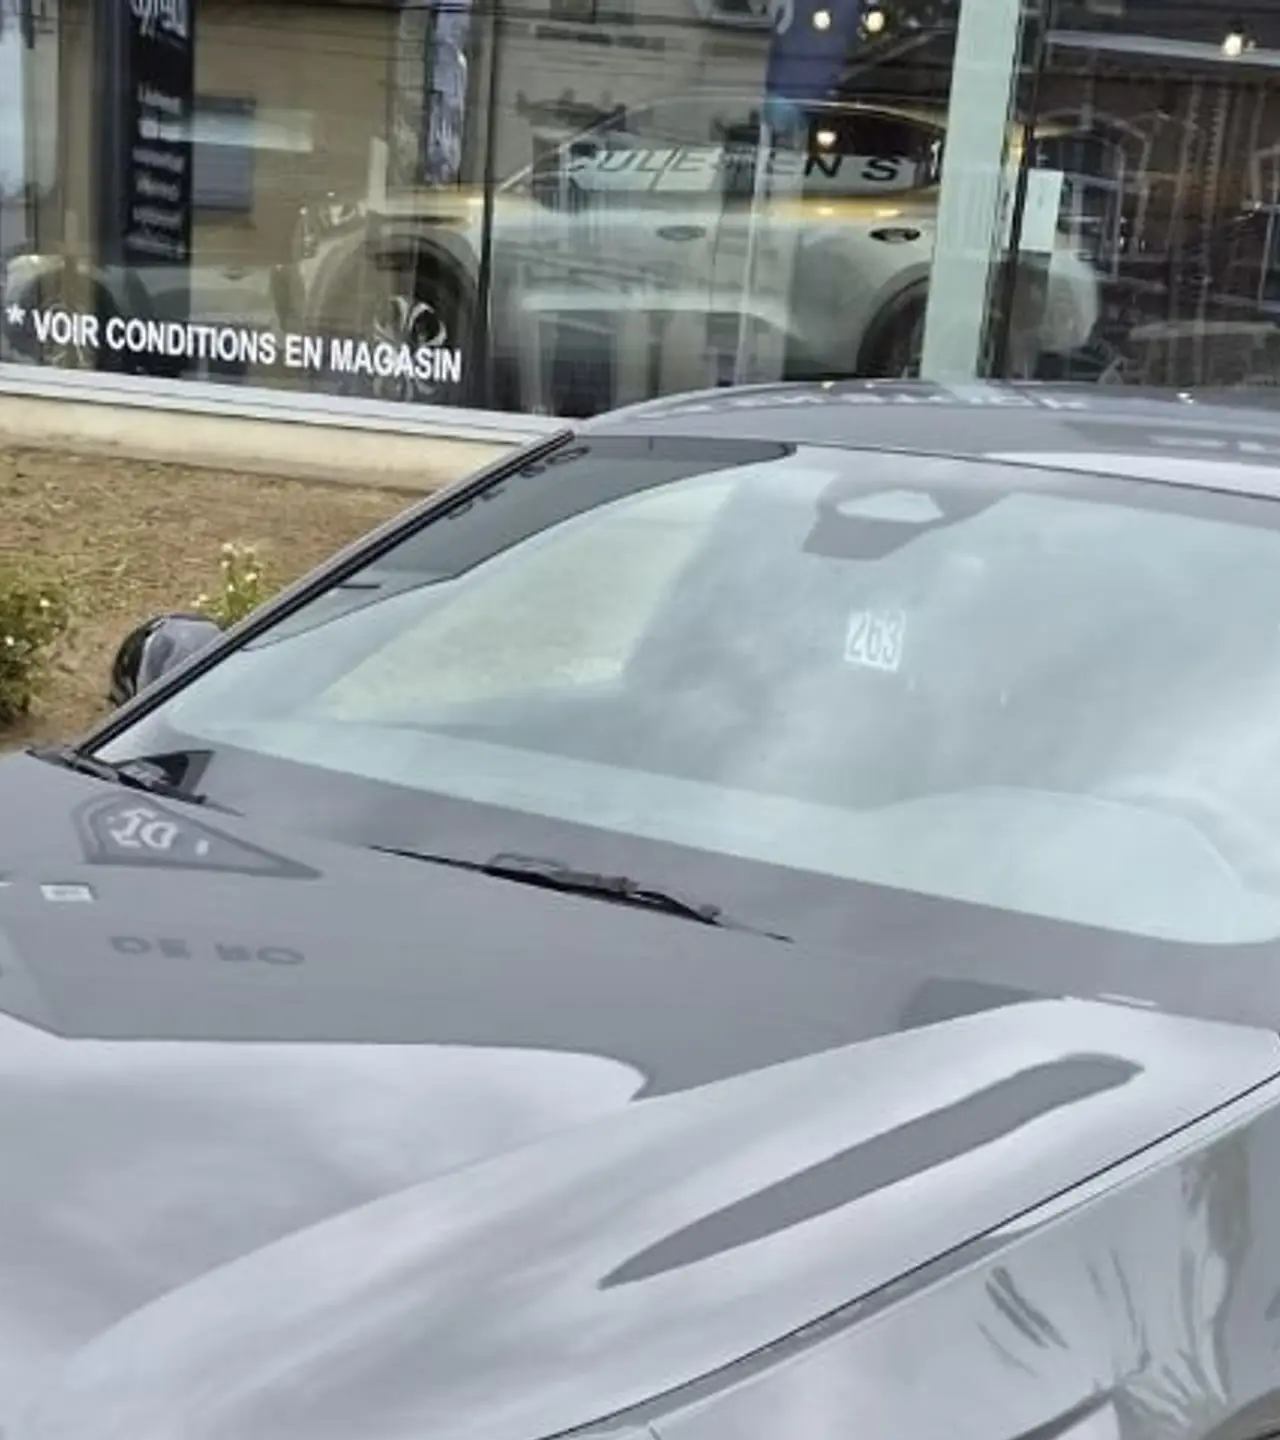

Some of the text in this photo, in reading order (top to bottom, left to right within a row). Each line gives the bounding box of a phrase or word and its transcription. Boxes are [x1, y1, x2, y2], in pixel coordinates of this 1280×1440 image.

[32, 308, 462, 383] VOIR CONDITIONS EN MAGASIN
